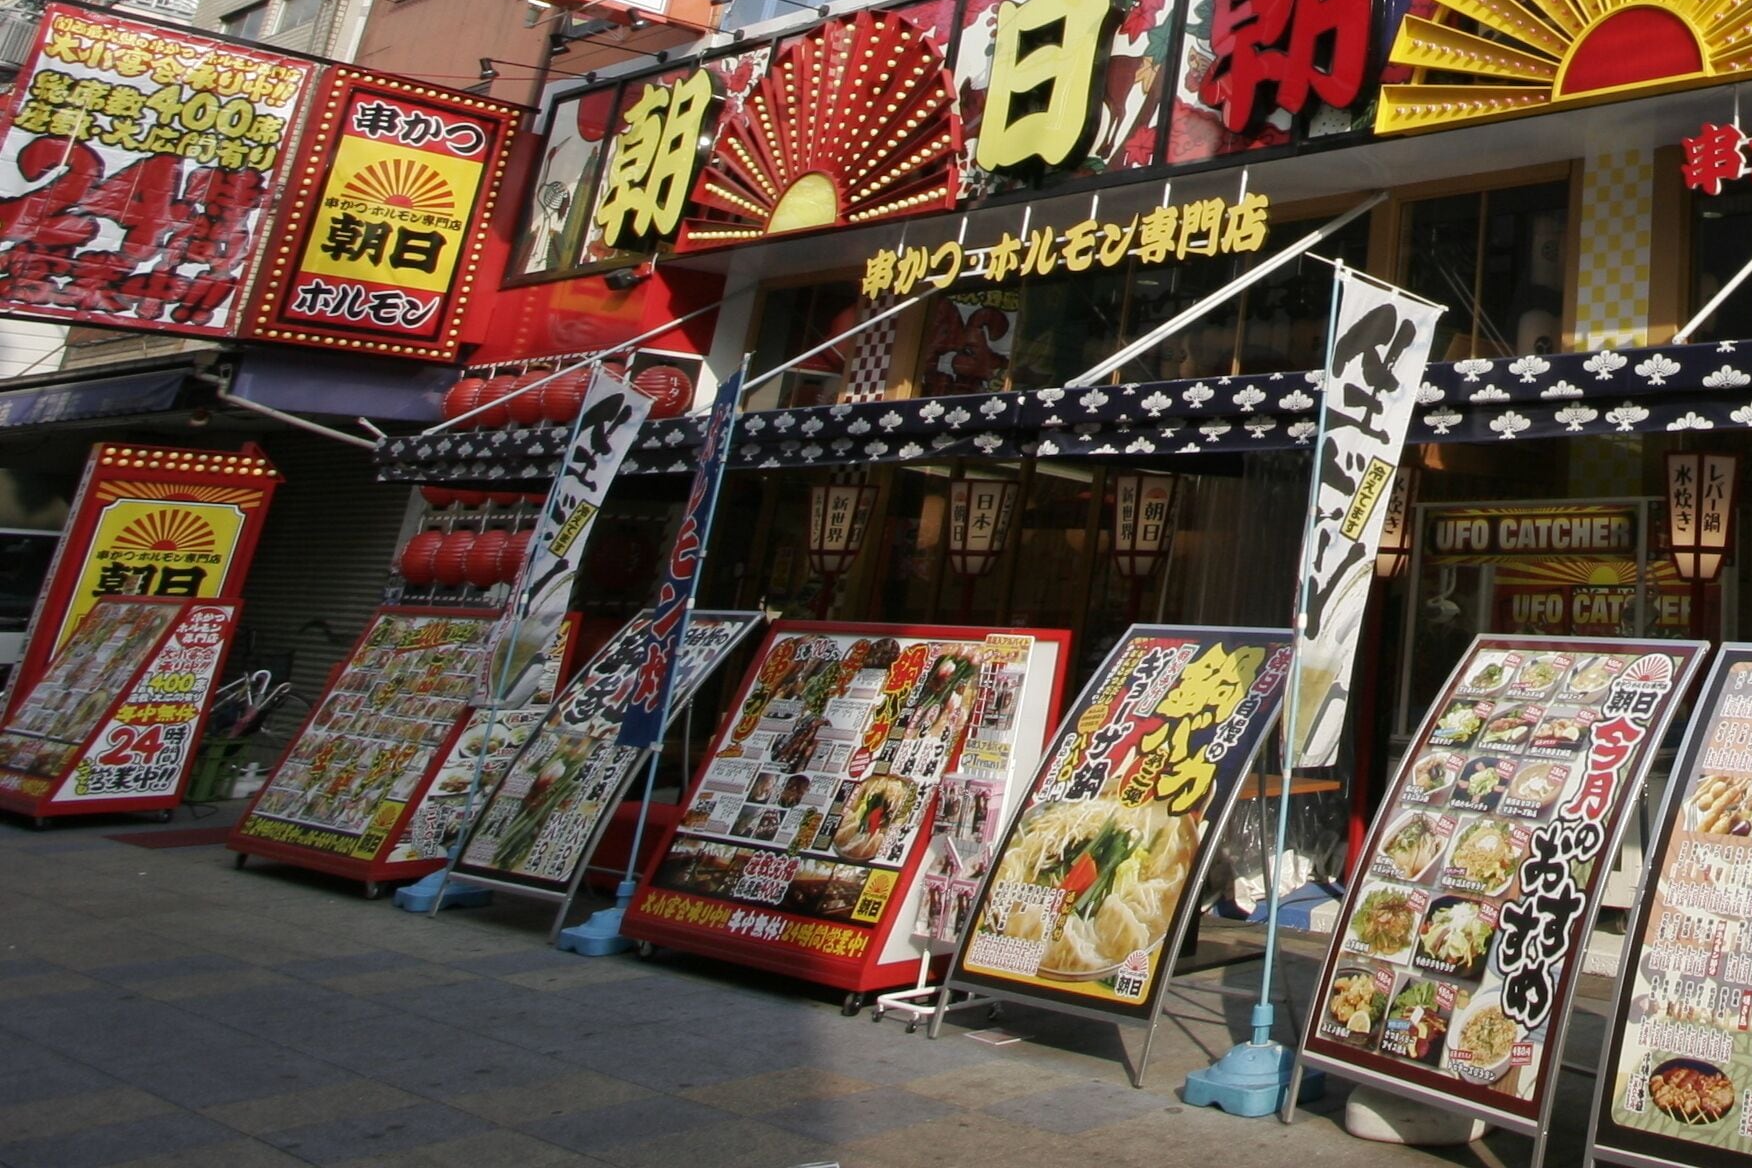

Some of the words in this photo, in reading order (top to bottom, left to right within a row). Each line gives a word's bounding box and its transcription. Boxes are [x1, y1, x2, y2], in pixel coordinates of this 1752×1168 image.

[354, 101, 486, 156] 串かつ
[320, 213, 447, 274] 朝日
[292, 279, 440, 329] ホルモン
[1673, 464, 1694, 532] 水炊き
[1702, 464, 1725, 534] レバー鍋
[1142, 501, 1165, 543] 朝日
[1435, 518, 1490, 552] UFO
[1500, 516, 1632, 549] CATCHER
[1512, 593, 1564, 626] UFO
[1606, 689, 1660, 716] 朝日
[1116, 974, 1143, 998] 朝日
